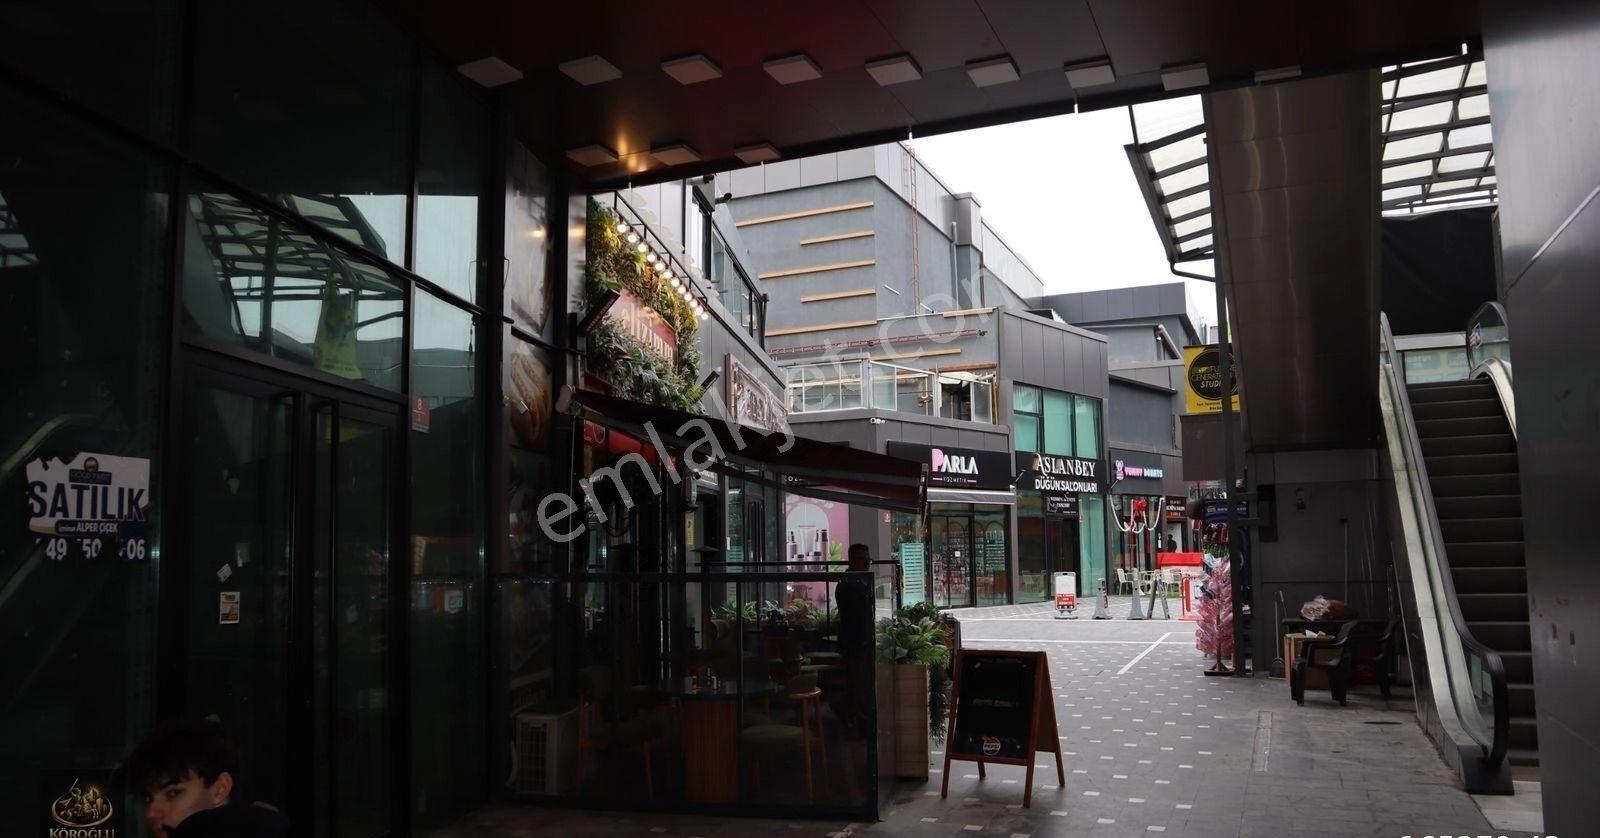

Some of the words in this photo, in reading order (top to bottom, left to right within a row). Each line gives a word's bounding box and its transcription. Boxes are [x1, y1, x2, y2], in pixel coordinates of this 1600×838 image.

[1200, 380, 1222, 389] STUDI
[931, 448, 979, 475] PARLA
[1034, 453, 1096, 477] ASLANBEY
[1035, 476, 1060, 491] DÜĞÜN
[1060, 480, 1098, 493] SALONLARI
[28, 480, 146, 521] SATILIK
[76, 521, 98, 533] ALPER
